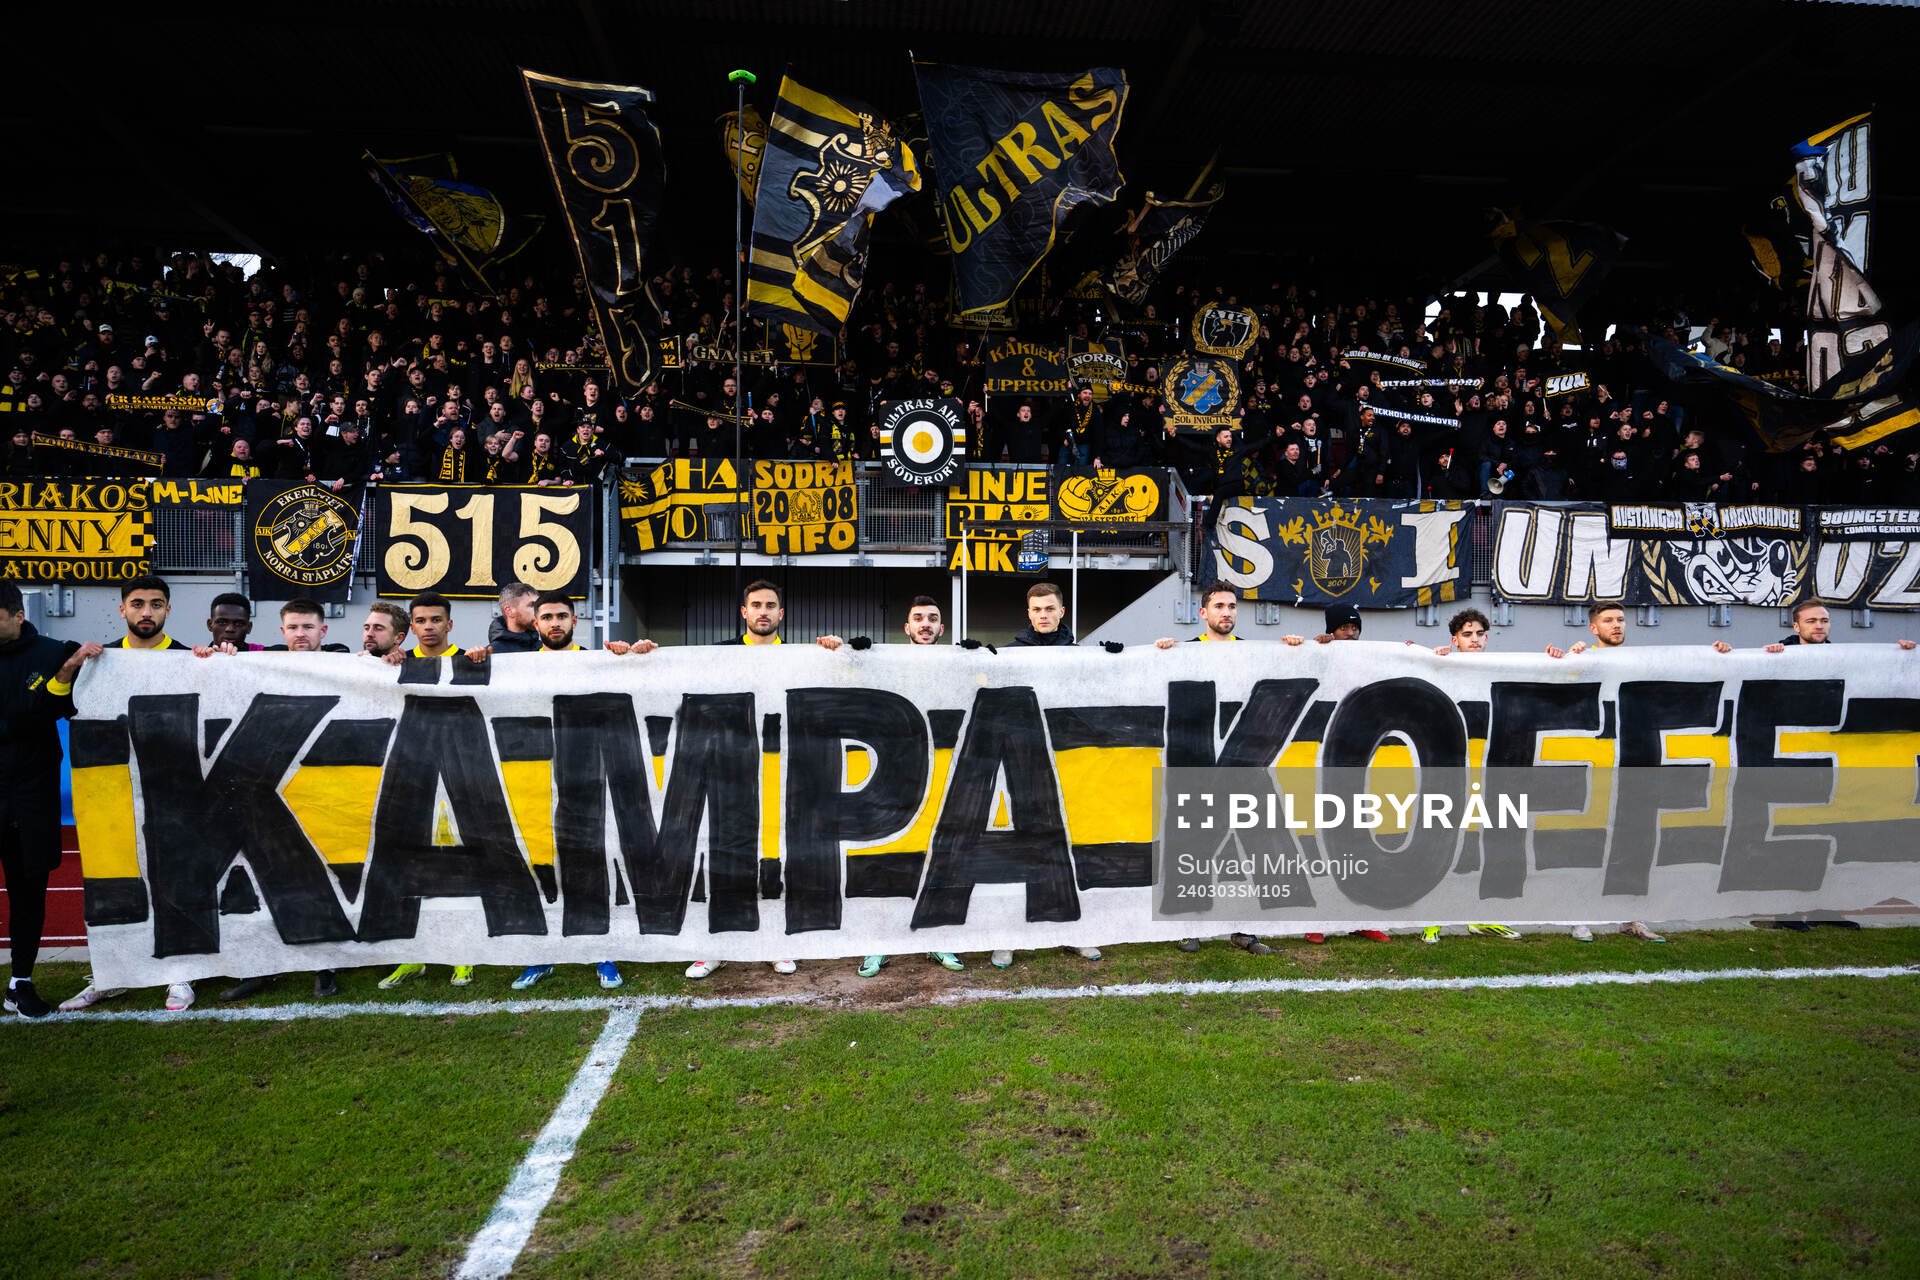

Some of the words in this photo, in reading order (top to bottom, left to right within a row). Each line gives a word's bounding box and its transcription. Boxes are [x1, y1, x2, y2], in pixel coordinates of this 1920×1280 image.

[943, 71, 1117, 254] ULTRAS
[1021, 357, 1036, 377] &
[1072, 353, 1123, 369] NORRA
[1379, 379, 1422, 387] ULTRAS
[1448, 378, 1481, 386] NORD
[131, 396, 206, 407] KARLSSON
[884, 398, 935, 430] ULTRAS
[938, 404, 960, 427] AIK
[1174, 415, 1191, 424] SOL
[1193, 415, 1231, 424] INVICTUS
[886, 458, 959, 485] SÖDERORT
[949, 470, 1048, 502] LINJE
[756, 490, 790, 523] 20
[822, 486, 854, 521] 08
[1821, 509, 1920, 525] YOUNGSTER
[256, 528, 272, 536] AIK
[949, 504, 1018, 538] BLÅ
[384, 492, 581, 592] 515
[757, 521, 855, 554] TIFO
[1214, 506, 1275, 589] S
[1401, 510, 1467, 589] I
[2, 560, 150, 580] ATOPOULOS
[263, 550, 299, 581] NORRA
[301, 552, 353, 582] STÅPLATS
[949, 541, 1016, 573] AIK
[1496, 509, 1634, 600] UN
[128, 654, 1082, 958] KÄMPA
[1159, 678, 1846, 914] KOFFE
